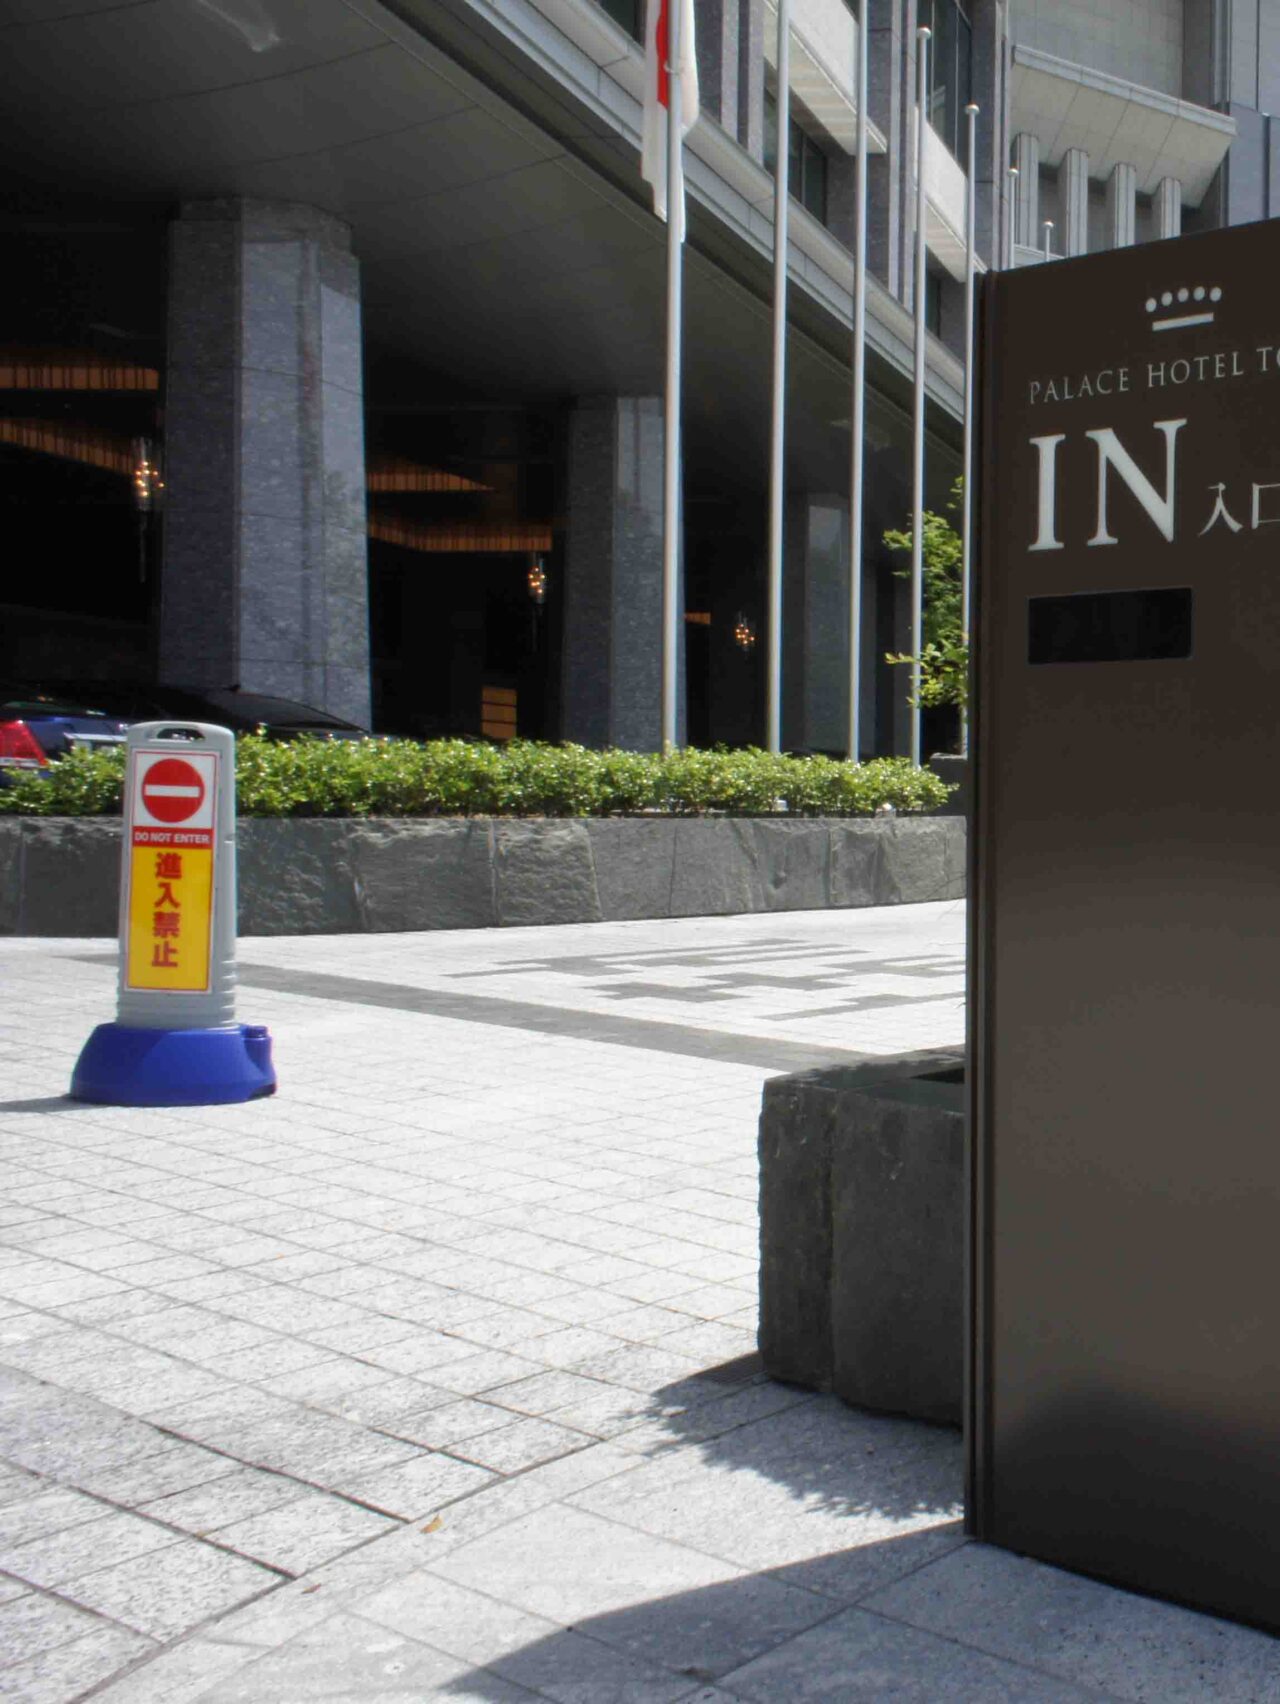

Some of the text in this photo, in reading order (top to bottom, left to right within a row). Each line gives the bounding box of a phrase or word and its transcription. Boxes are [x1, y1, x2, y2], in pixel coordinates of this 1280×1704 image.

[1029, 368, 1129, 404] PALACE
[1147, 351, 1244, 388] HOTEL
[1028, 418, 1188, 551] IN
[134, 831, 210, 845] DO NOT ENTER
[151, 852, 182, 968] 進入禁止
